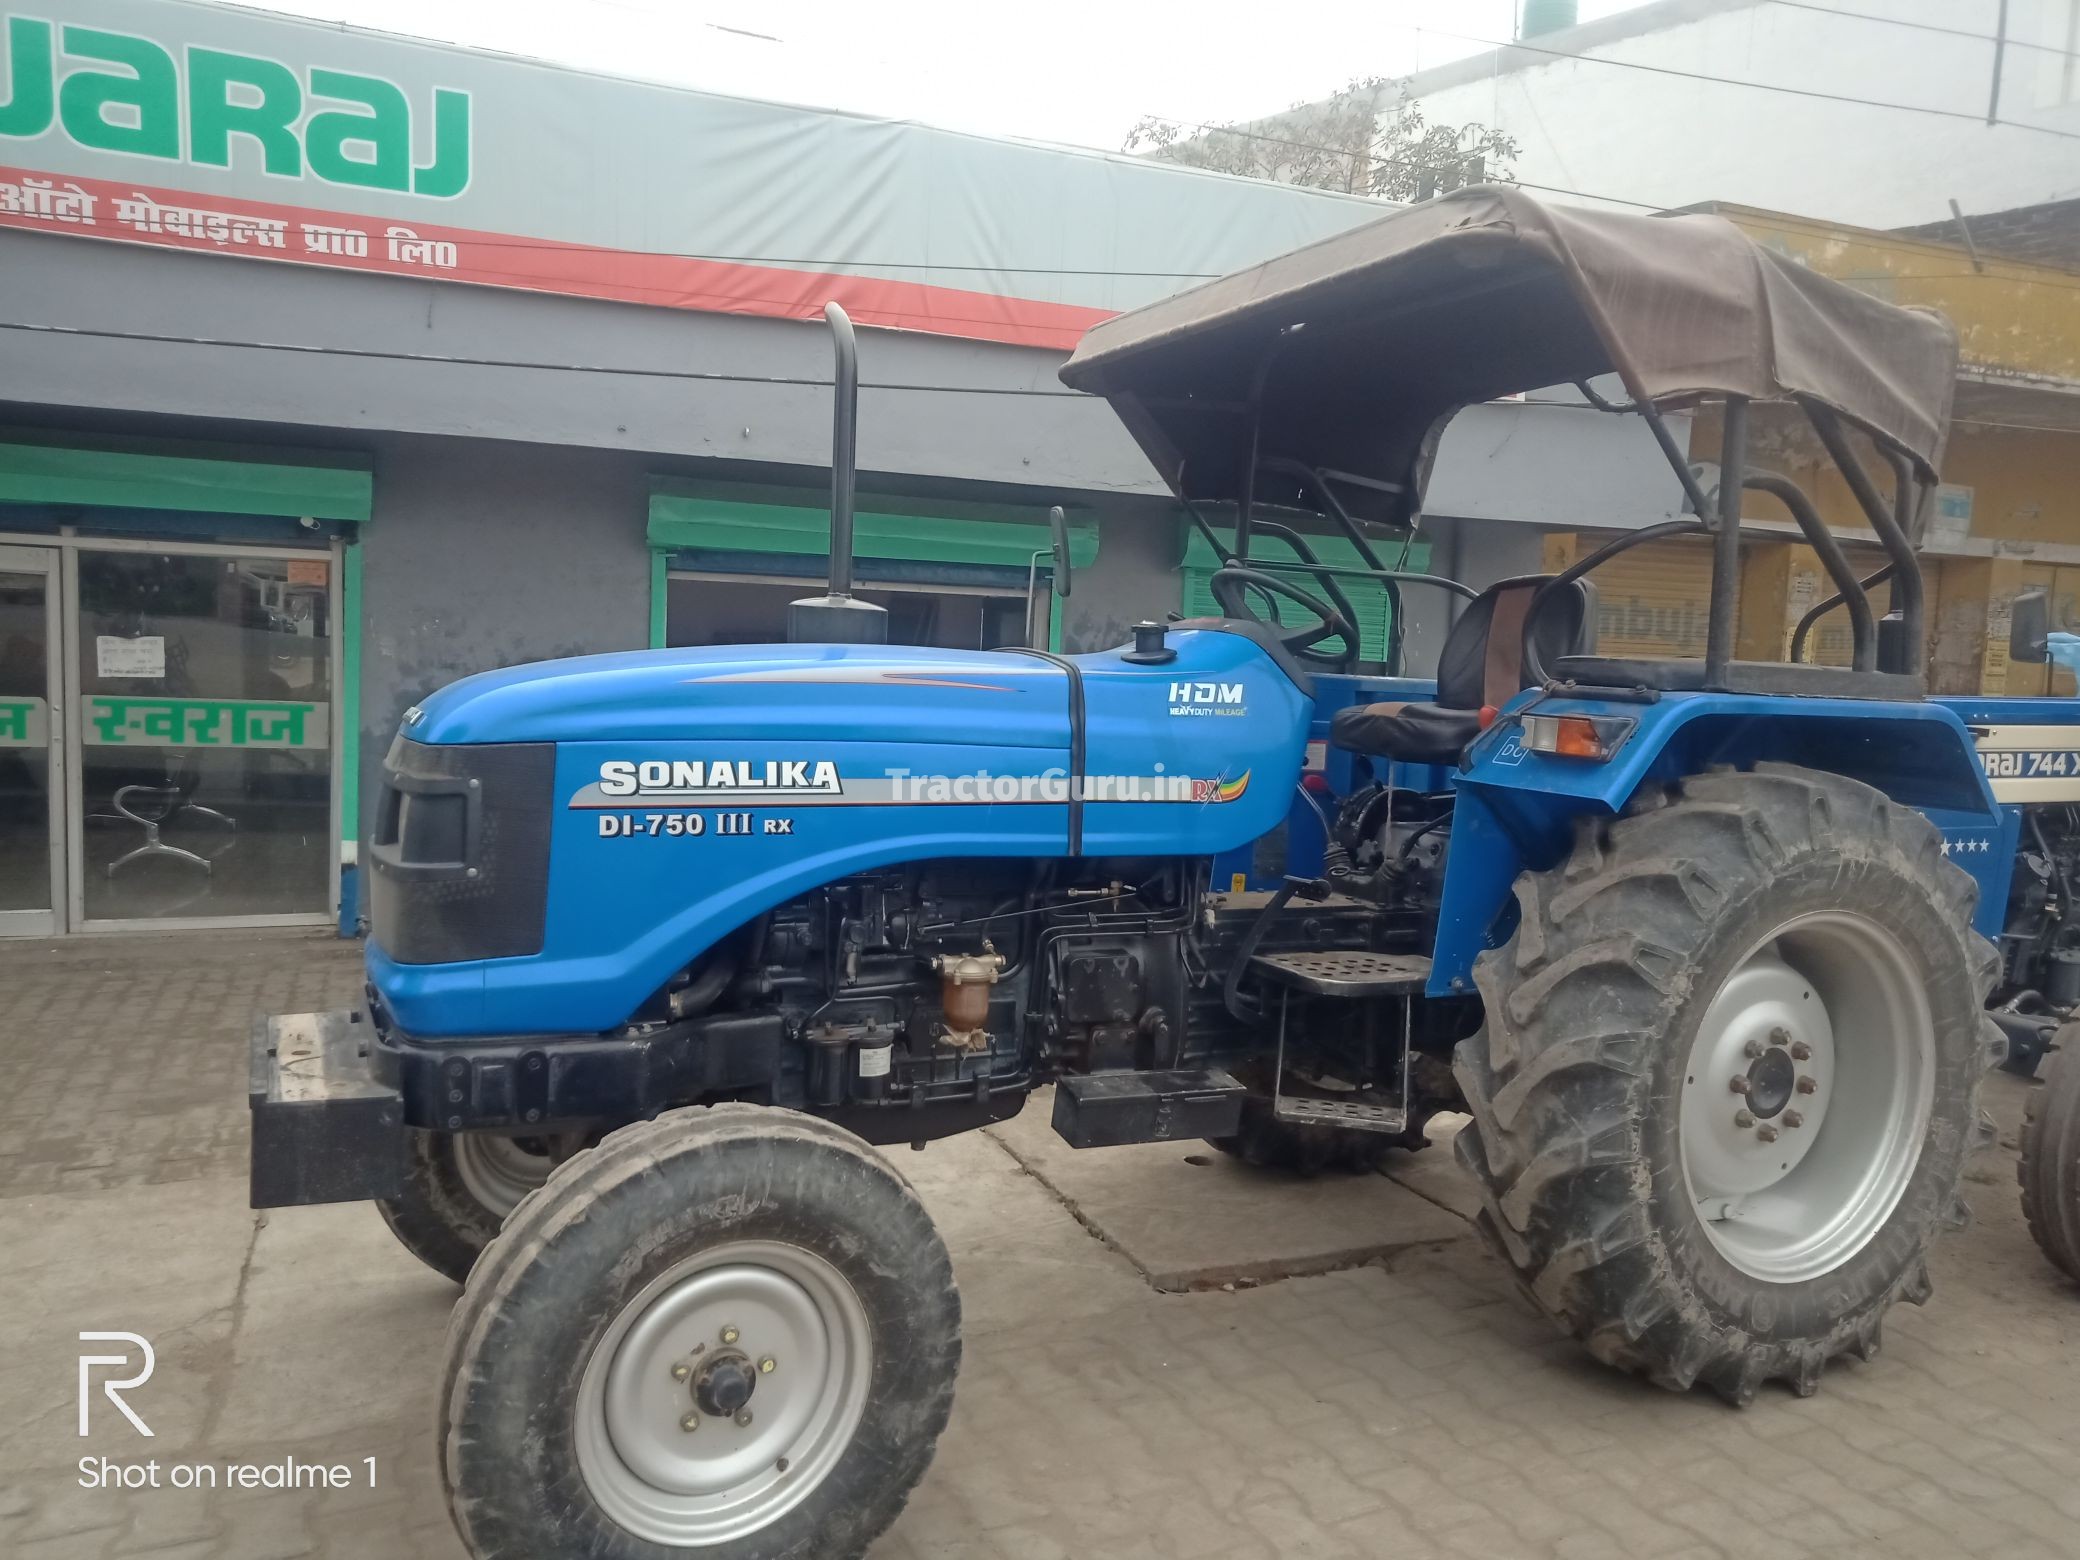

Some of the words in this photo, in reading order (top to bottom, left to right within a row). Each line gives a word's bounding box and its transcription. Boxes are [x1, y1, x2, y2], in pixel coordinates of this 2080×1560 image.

[1168, 682, 1244, 704] HDM
[92, 698, 314, 744] स्वराज
[2027, 753, 2067, 777] 744
[599, 761, 844, 796] SONALIKA
[1191, 777, 1223, 803] RX
[598, 813, 707, 838] DI-750
[715, 812, 754, 836] III
[764, 818, 794, 834] RX
